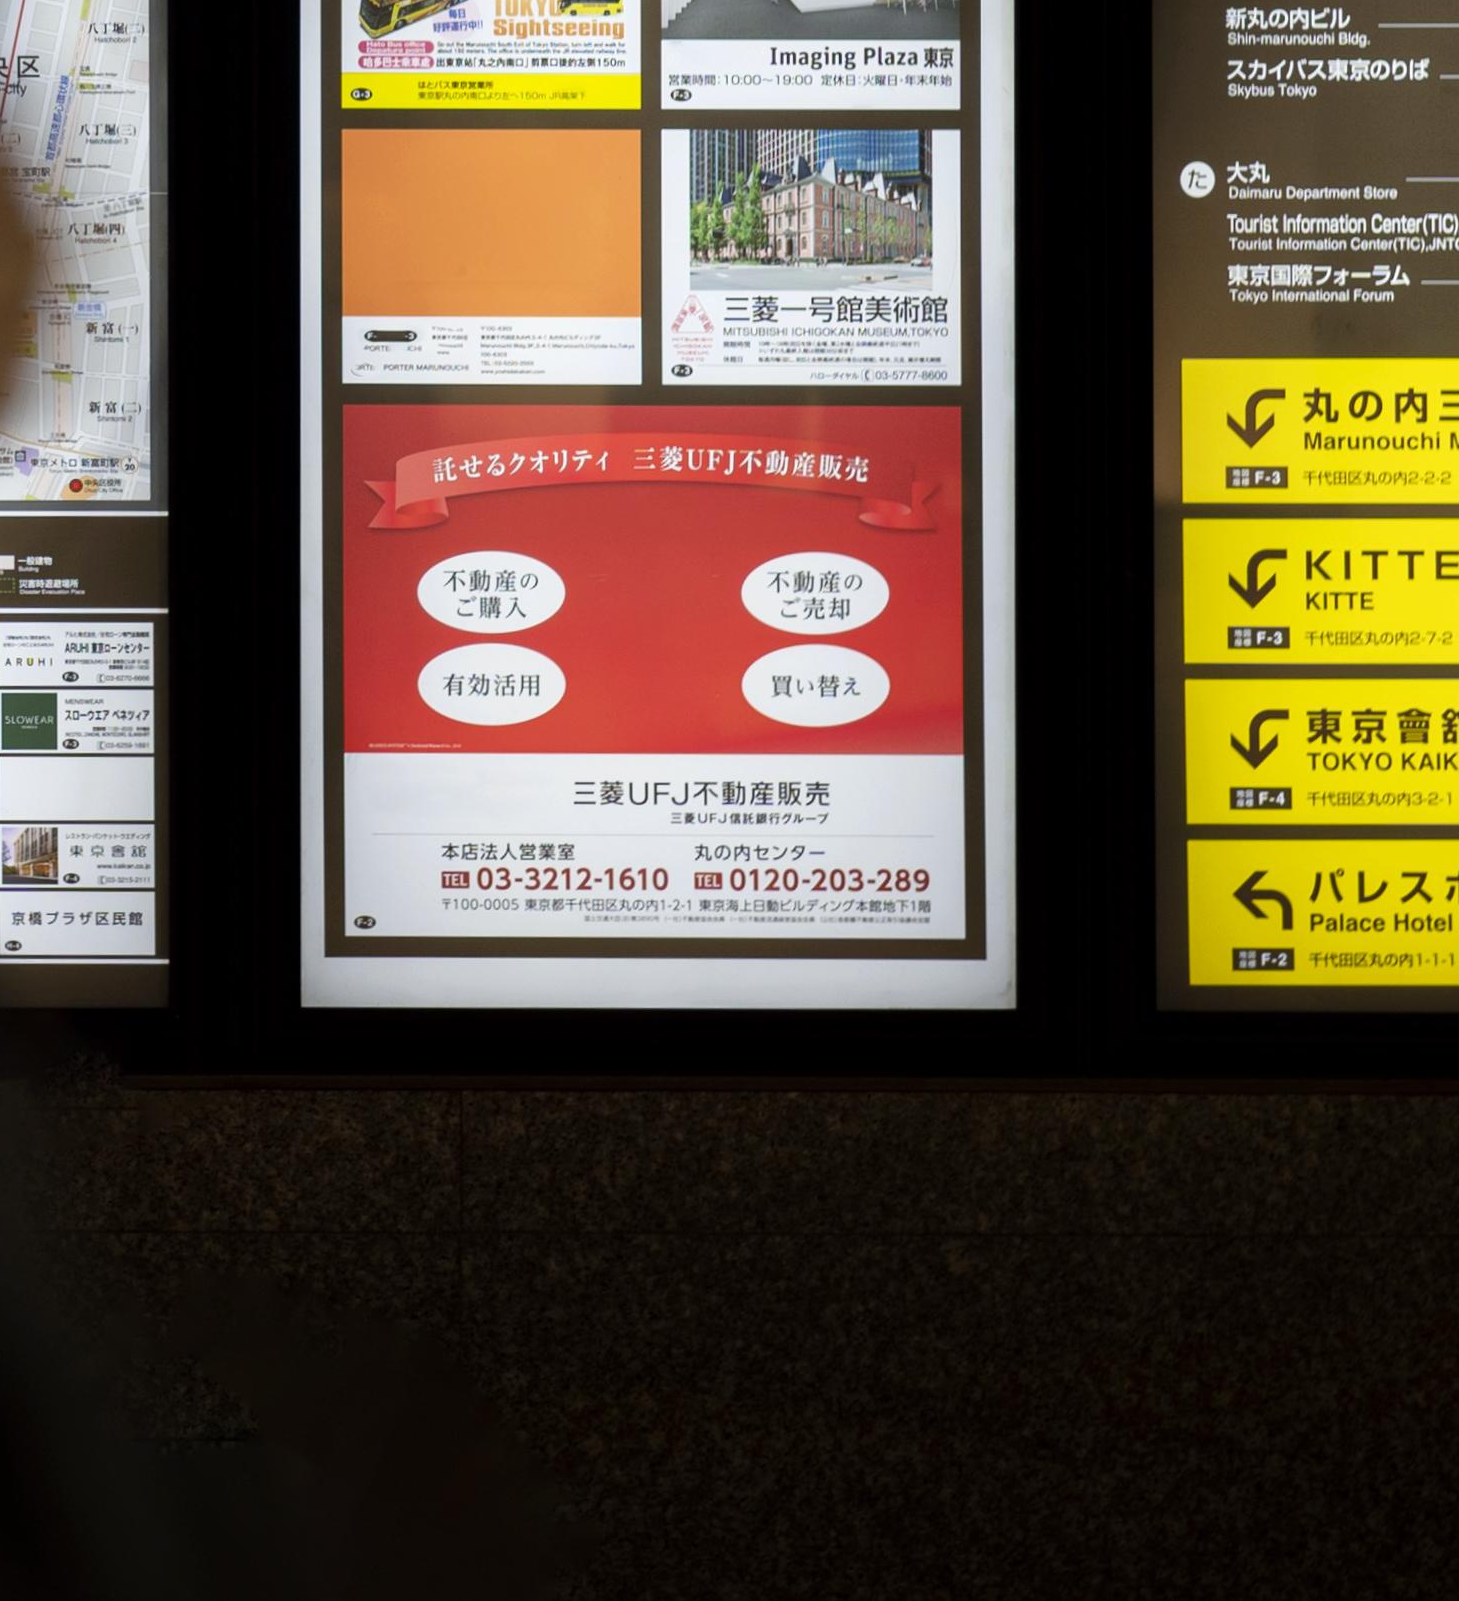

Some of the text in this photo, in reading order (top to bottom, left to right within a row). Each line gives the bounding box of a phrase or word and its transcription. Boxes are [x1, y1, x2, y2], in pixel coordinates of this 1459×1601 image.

[490, 15, 628, 42] Sightseeing
[770, 45, 954, 71] Imaging Plaza 東京
[1223, 57, 1434, 84] スカイバス東京のりば
[1227, 213, 1278, 234] Tourist
[1282, 213, 1366, 234] Information
[1223, 262, 1414, 289] 東京国際フォーラム
[724, 295, 949, 324] 三菱一号館美術館
[722, 327, 949, 338] MITSUBISHI ICHIGOKAN MUSEUM,TOKYO
[874, 368, 948, 381] 03-5777-8600
[1303, 431, 1441, 451] Marunouchi
[432, 445, 869, 484] 託せるクオリティ 三菱UFJ不動産販売
[444, 569, 539, 593] 不動産の
[769, 570, 863, 594] 不動産の
[456, 595, 527, 619] ご購入
[780, 597, 851, 621] ご売却
[1305, 591, 1374, 611] KITTE
[444, 672, 540, 697] 有効活用
[771, 674, 861, 698] 買い替え
[1306, 751, 1393, 772] TOKYO
[573, 780, 830, 807] 三菱UFJ不動産販売
[671, 812, 829, 825] 三菱UFJ信託銀行グループ
[441, 842, 575, 861] 本店法人営業室
[694, 843, 826, 863] 丸の内センター
[442, 872, 469, 888] TEL
[476, 866, 669, 892] 03-3212-1610
[694, 873, 722, 889] TEL
[729, 868, 930, 893] 0120-203-289
[12, 911, 144, 927] 京橋プラザ区民館
[1309, 912, 1386, 933] Palace
[1393, 913, 1453, 933] Hotel
